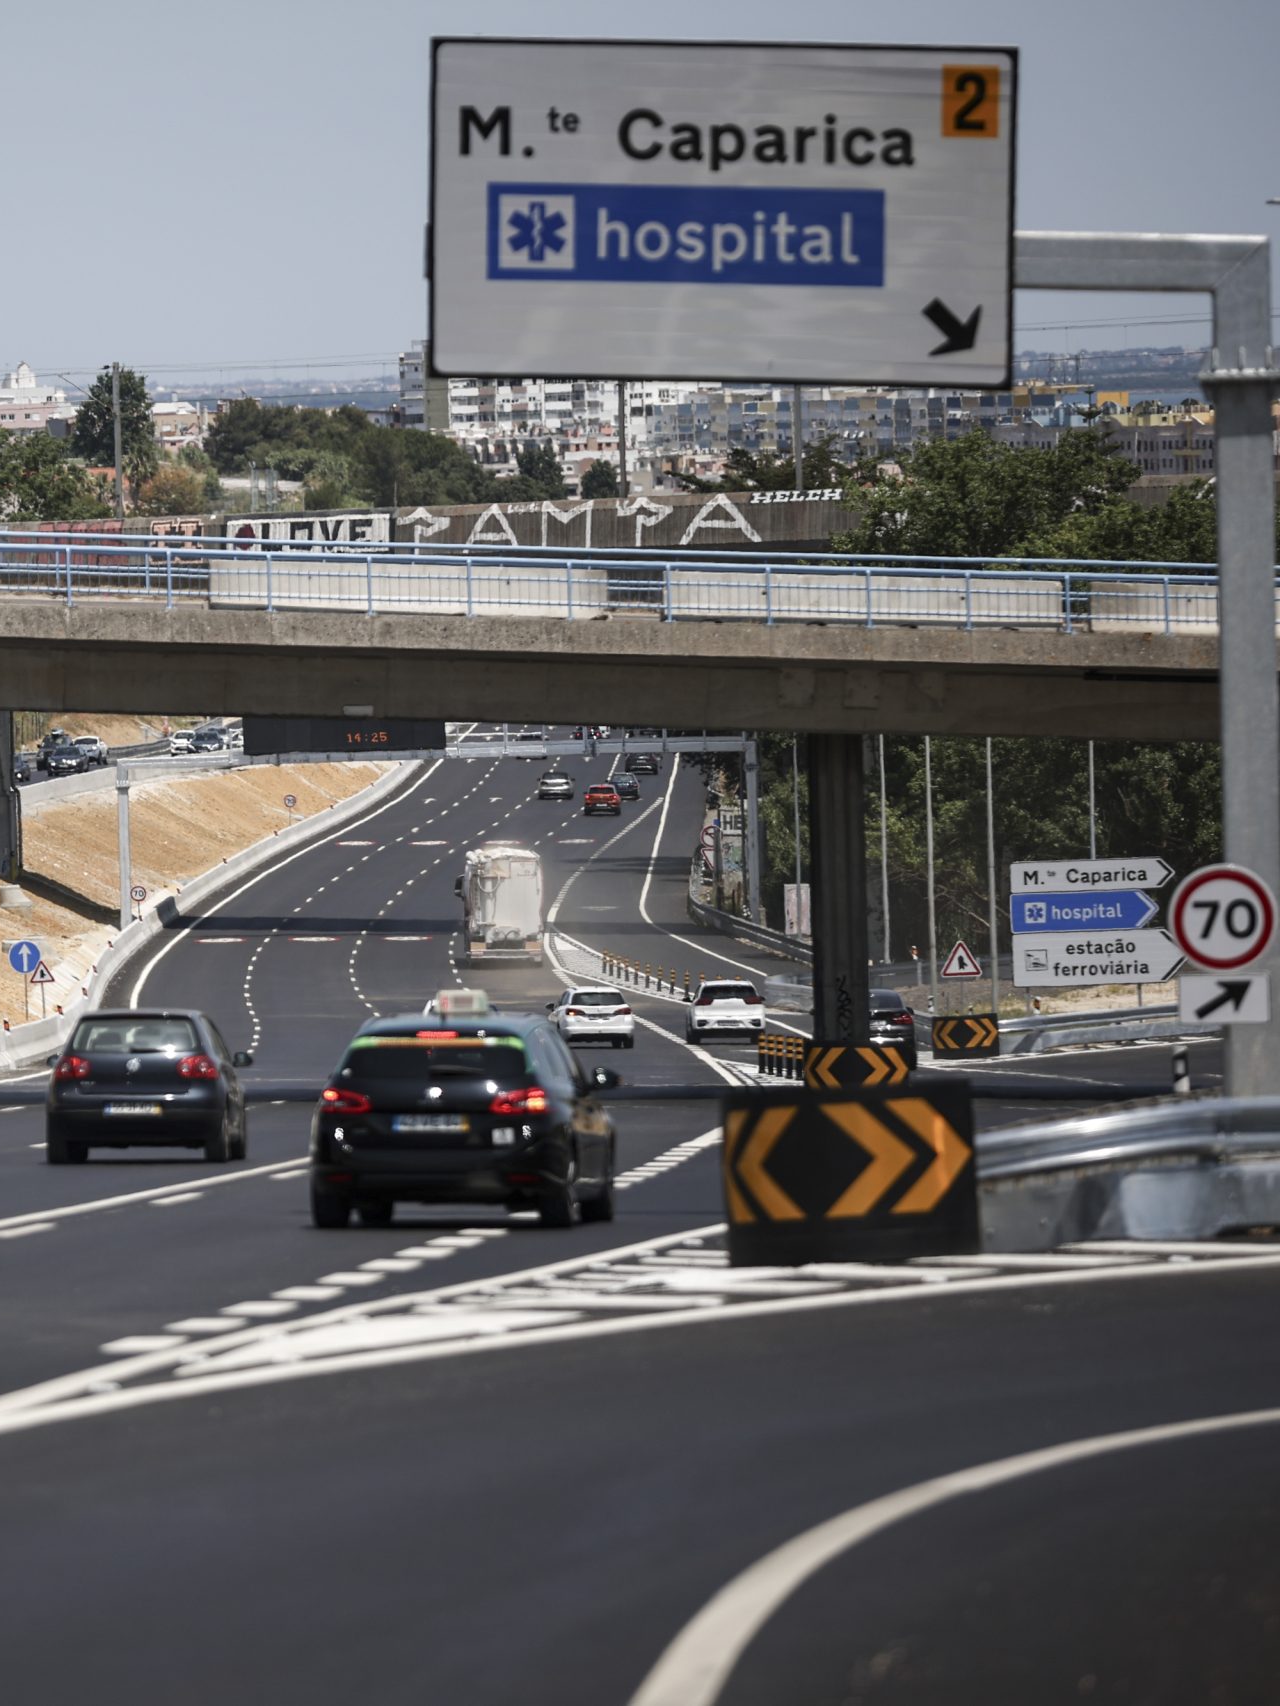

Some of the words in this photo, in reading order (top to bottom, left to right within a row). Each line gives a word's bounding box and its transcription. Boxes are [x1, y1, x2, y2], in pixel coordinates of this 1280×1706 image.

[953, 72, 988, 131] 2
[619, 108, 915, 172] Caparica
[597, 208, 859, 272] hospital
[346, 731, 388, 743] 14:25
[1066, 867, 1148, 886] Caparica
[133, 890, 145, 898] 70
[1051, 902, 1123, 922] hospital
[1192, 899, 1258, 940] 70
[1065, 939, 1136, 957] estação
[1053, 960, 1150, 977] ferroviária
